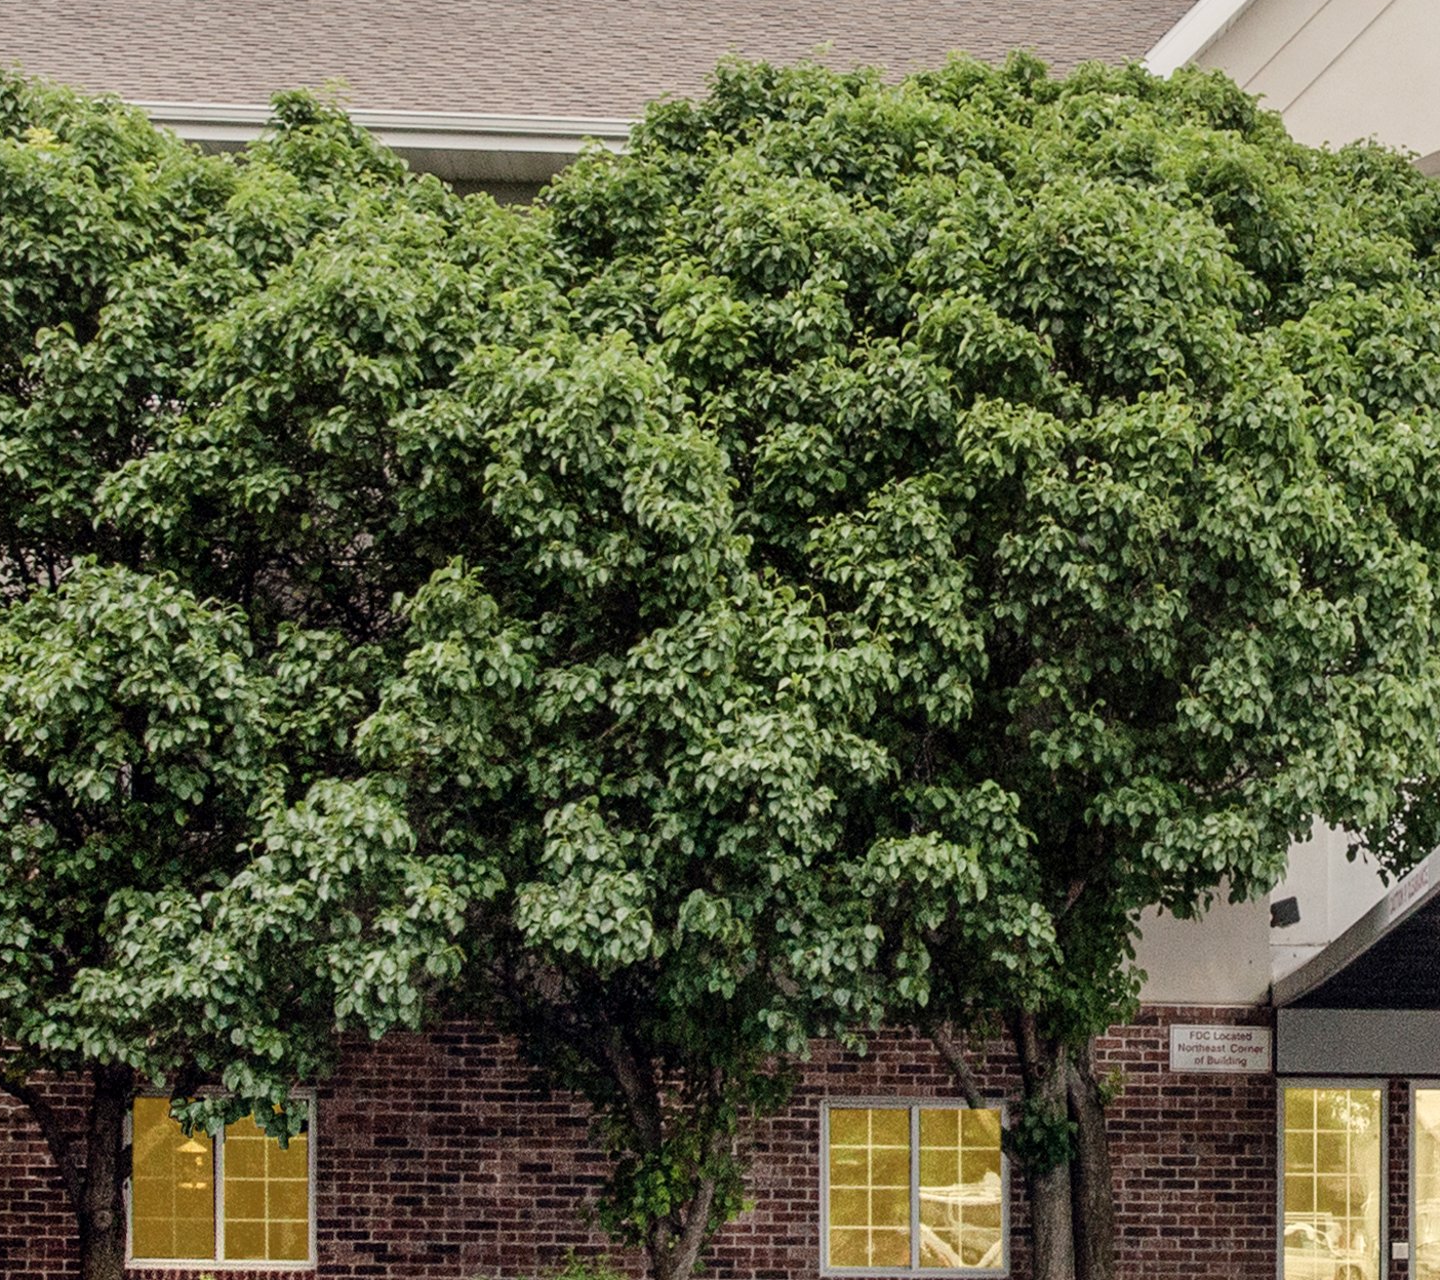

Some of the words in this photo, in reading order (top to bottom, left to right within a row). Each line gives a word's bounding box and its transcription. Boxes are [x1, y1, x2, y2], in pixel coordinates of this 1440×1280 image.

[1190, 1031, 1210, 1040] FDC
[1214, 1031, 1252, 1040] Located
[1178, 1043, 1225, 1053] Northeast
[1230, 1044, 1264, 1053] Corner
[1194, 1056, 1204, 1065] of
[1207, 1056, 1247, 1067] Building
